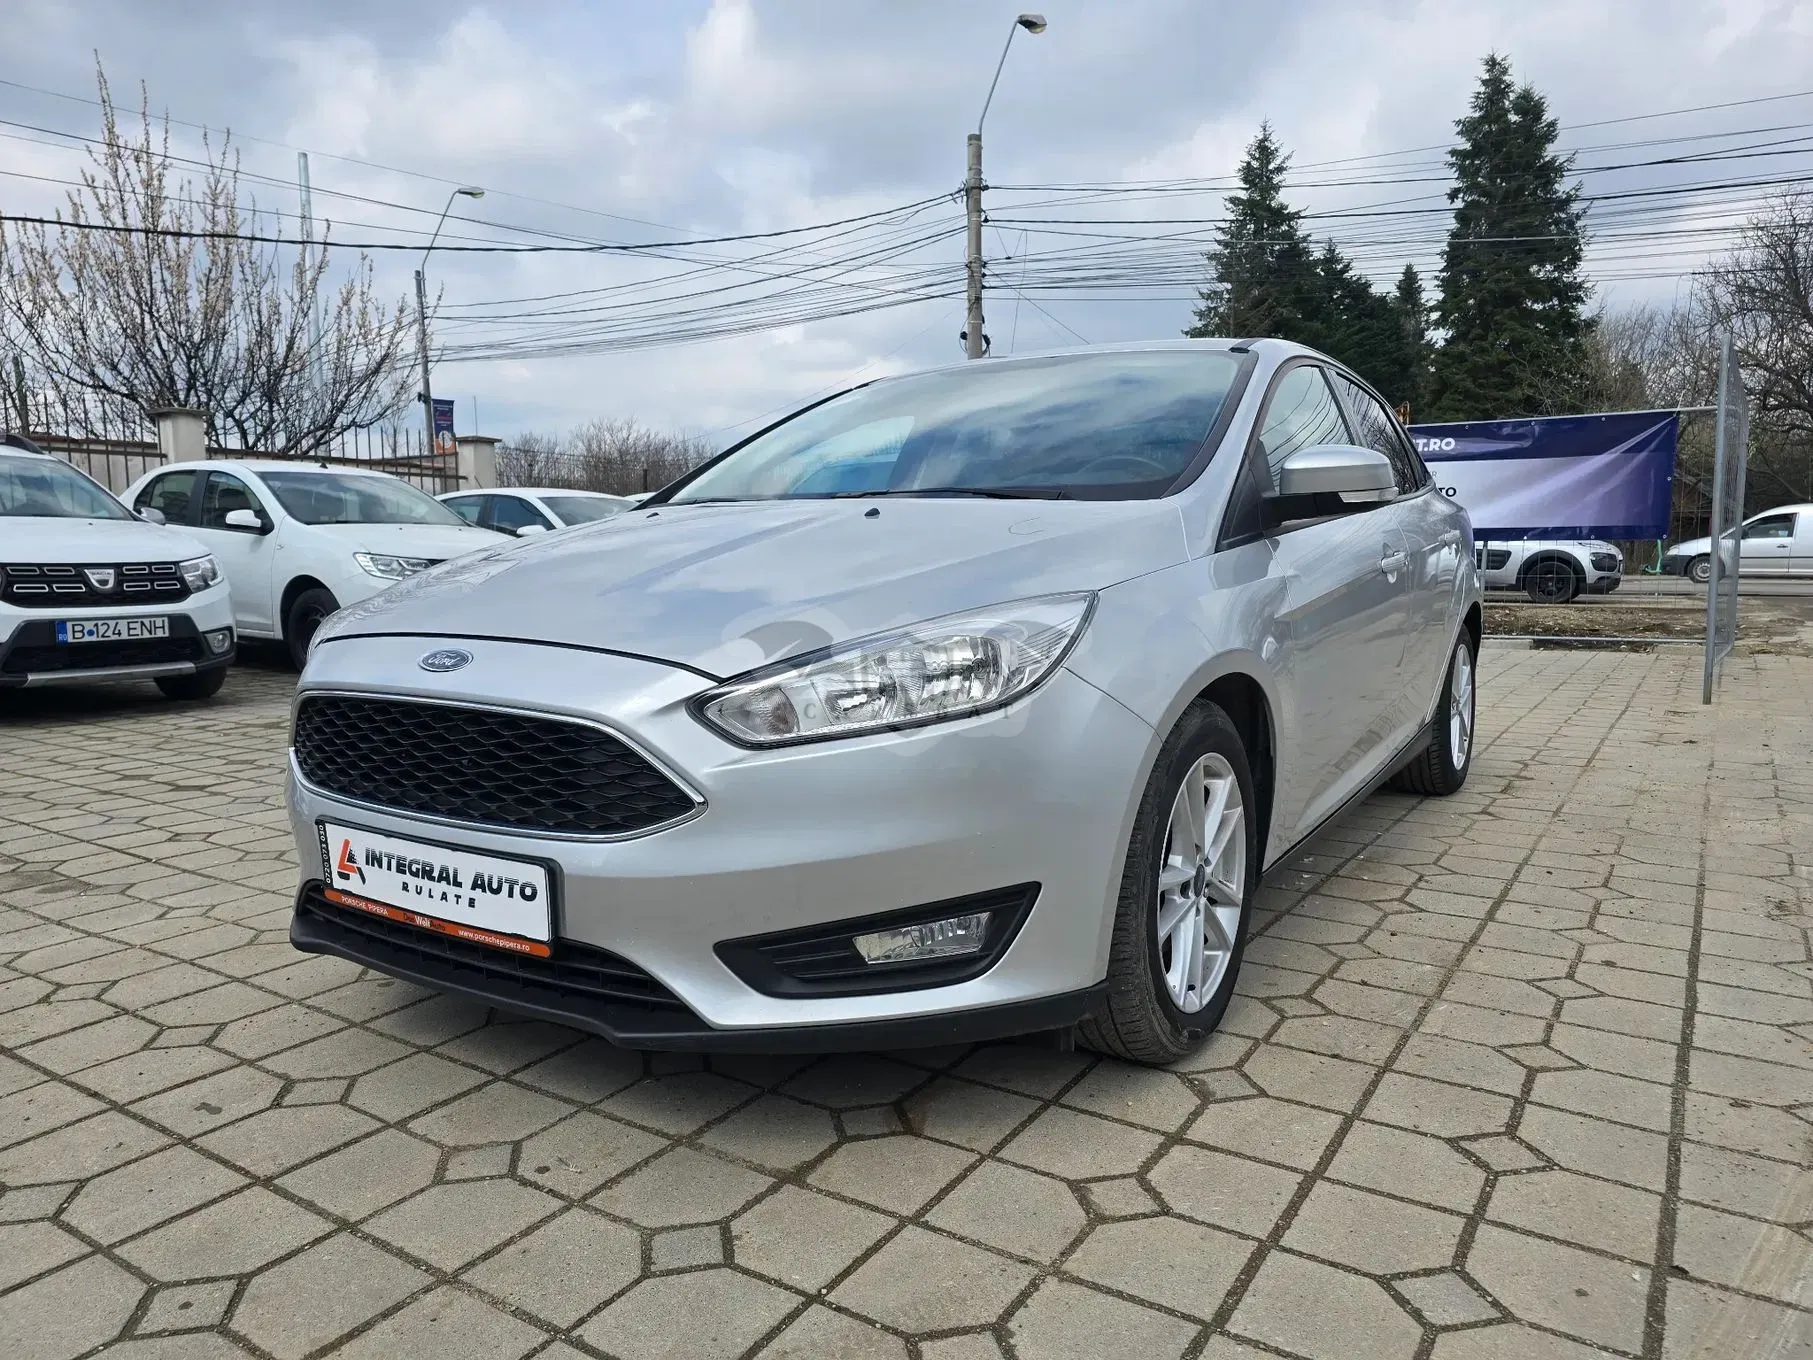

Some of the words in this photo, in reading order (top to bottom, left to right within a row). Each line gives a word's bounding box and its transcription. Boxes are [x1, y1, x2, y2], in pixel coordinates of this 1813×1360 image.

[1413, 437, 1456, 452] T.RO
[72, 624, 85, 640] B
[93, 622, 122, 639] 124
[127, 619, 166, 637] ENH
[365, 847, 463, 889] INTEGRAL
[470, 871, 538, 902] AUTO
[402, 881, 476, 908] RULATE
[341, 895, 367, 910] PORSCHE
[367, 903, 389, 917] PIPERA
[458, 929, 530, 952] www.porschepipera.ro
